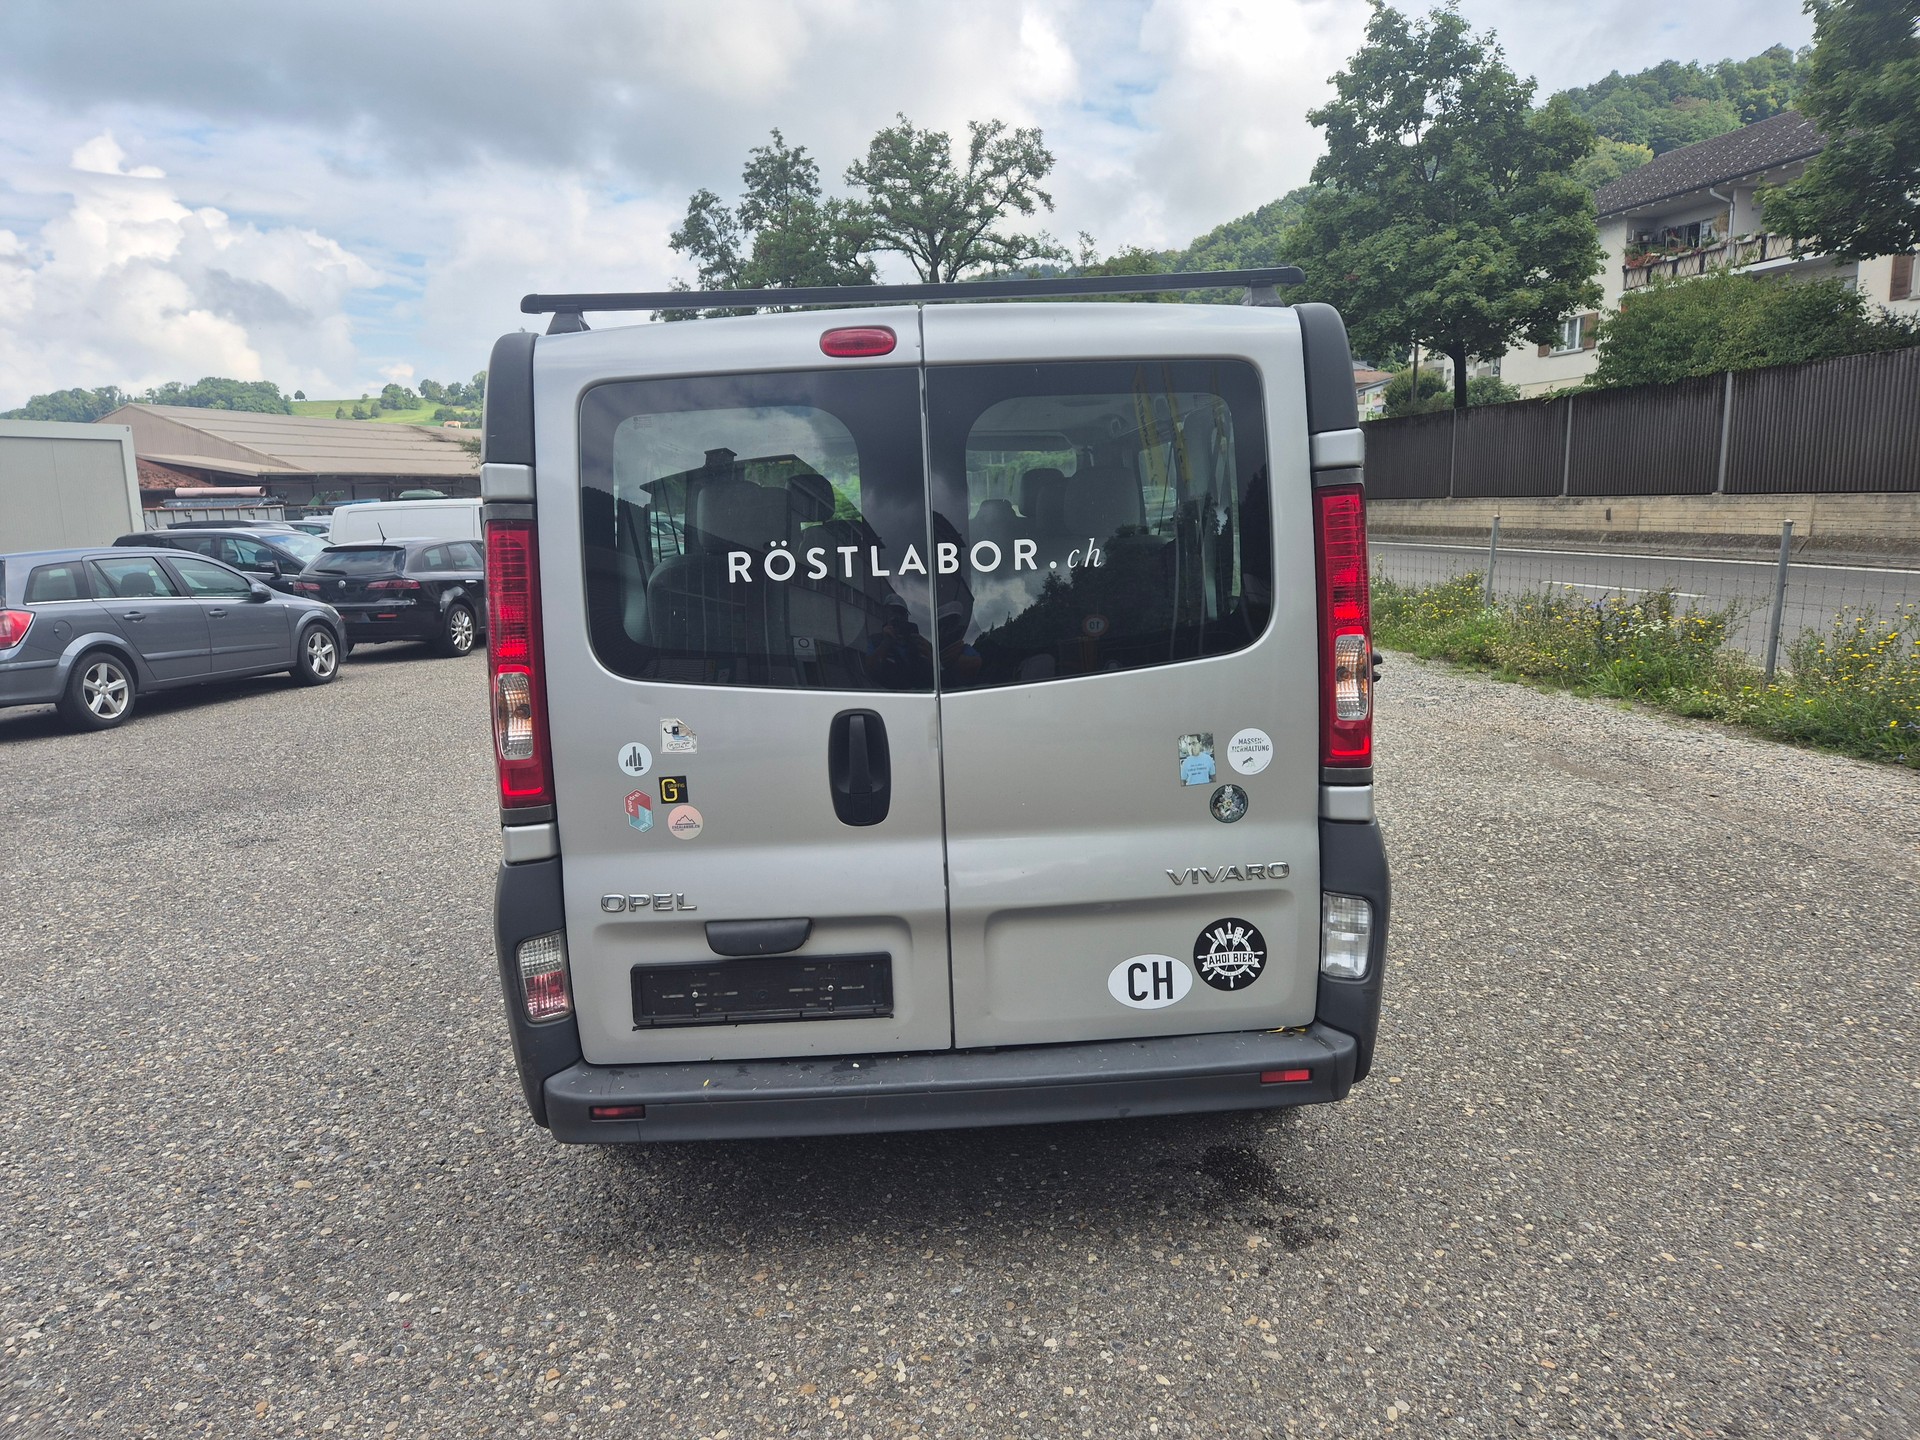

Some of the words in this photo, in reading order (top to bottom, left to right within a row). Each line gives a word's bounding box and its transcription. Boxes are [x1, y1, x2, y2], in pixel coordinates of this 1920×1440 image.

[728, 538, 1102, 583] RÖSTLABOR.ch
[1165, 861, 1290, 885] VIVARO
[600, 893, 697, 913] OPEL
[1209, 953, 1230, 965] AHOI
[1233, 952, 1254, 963] BIER
[1127, 961, 1174, 1002] CH
